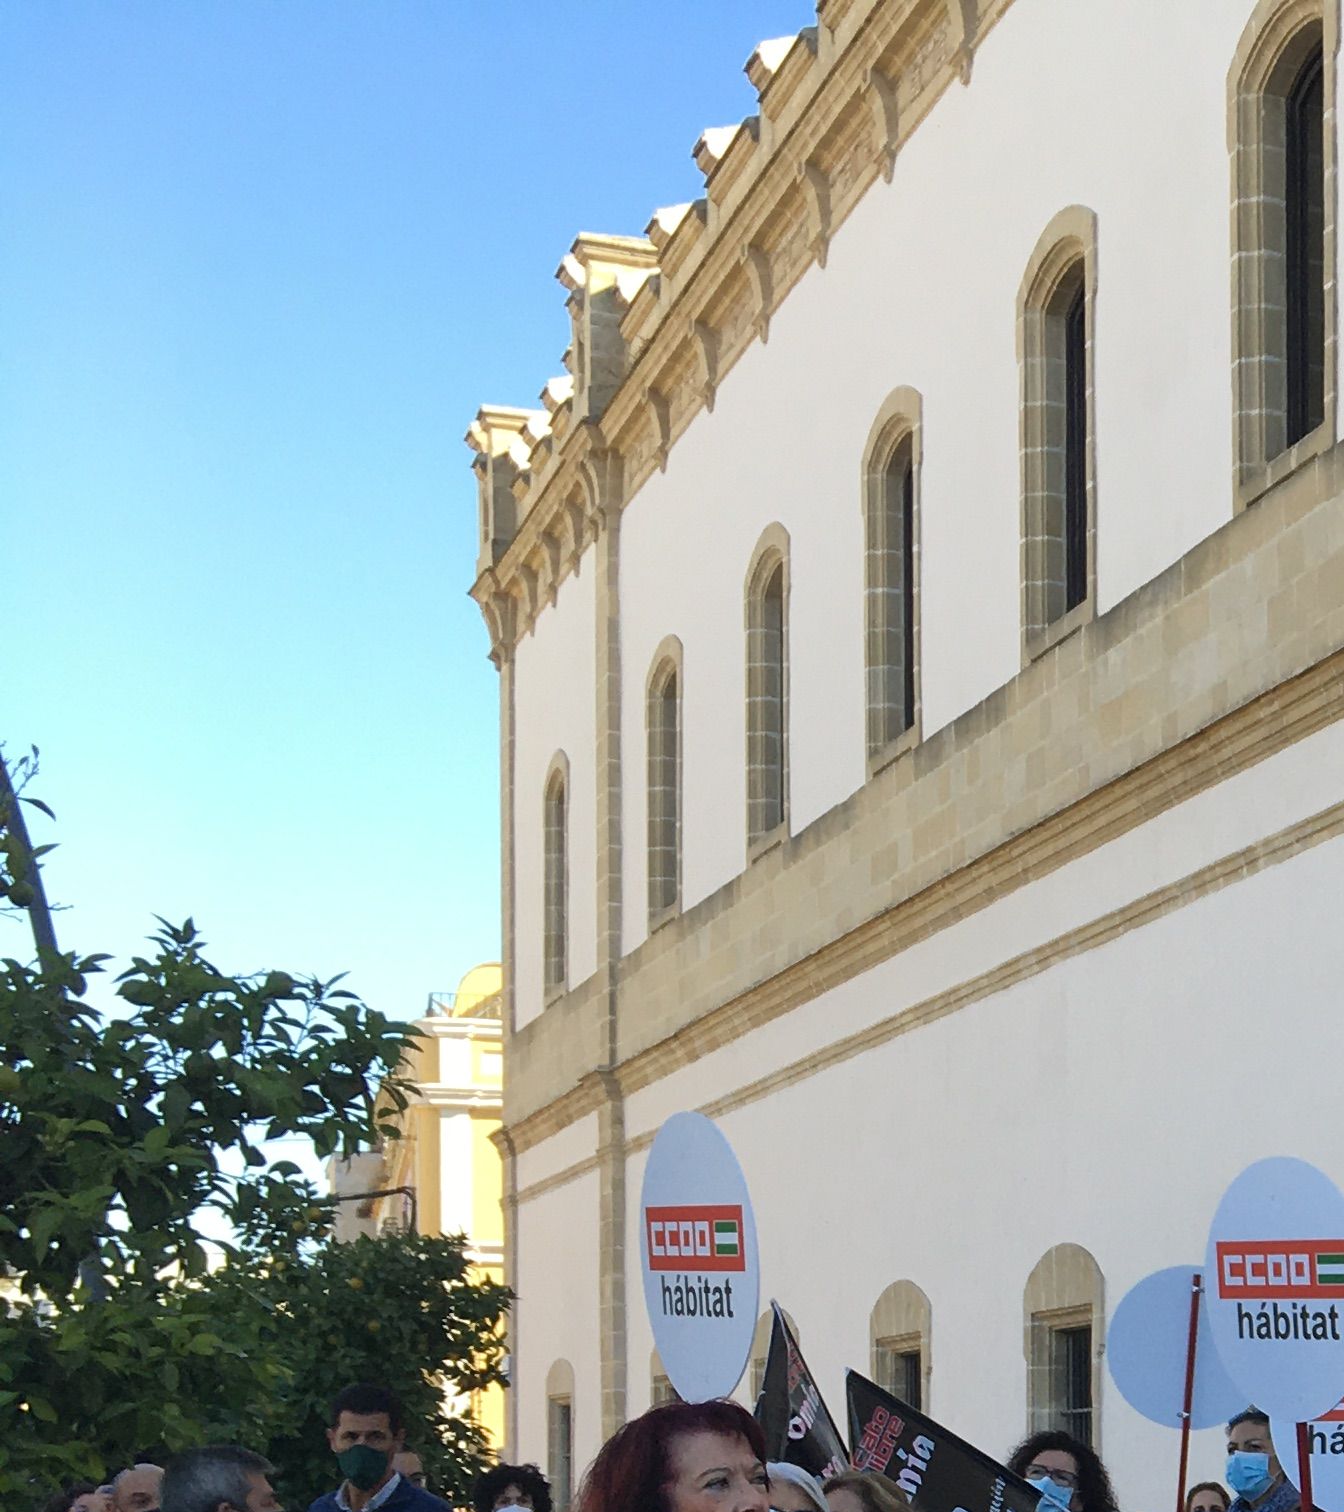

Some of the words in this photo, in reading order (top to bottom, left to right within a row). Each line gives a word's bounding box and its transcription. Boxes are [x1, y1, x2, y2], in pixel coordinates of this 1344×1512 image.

[650, 1220, 710, 1256] CCOO
[1223, 1254, 1310, 1286] CCOO
[661, 1275, 733, 1319] hábitat
[1237, 1302, 1340, 1342] hábitat
